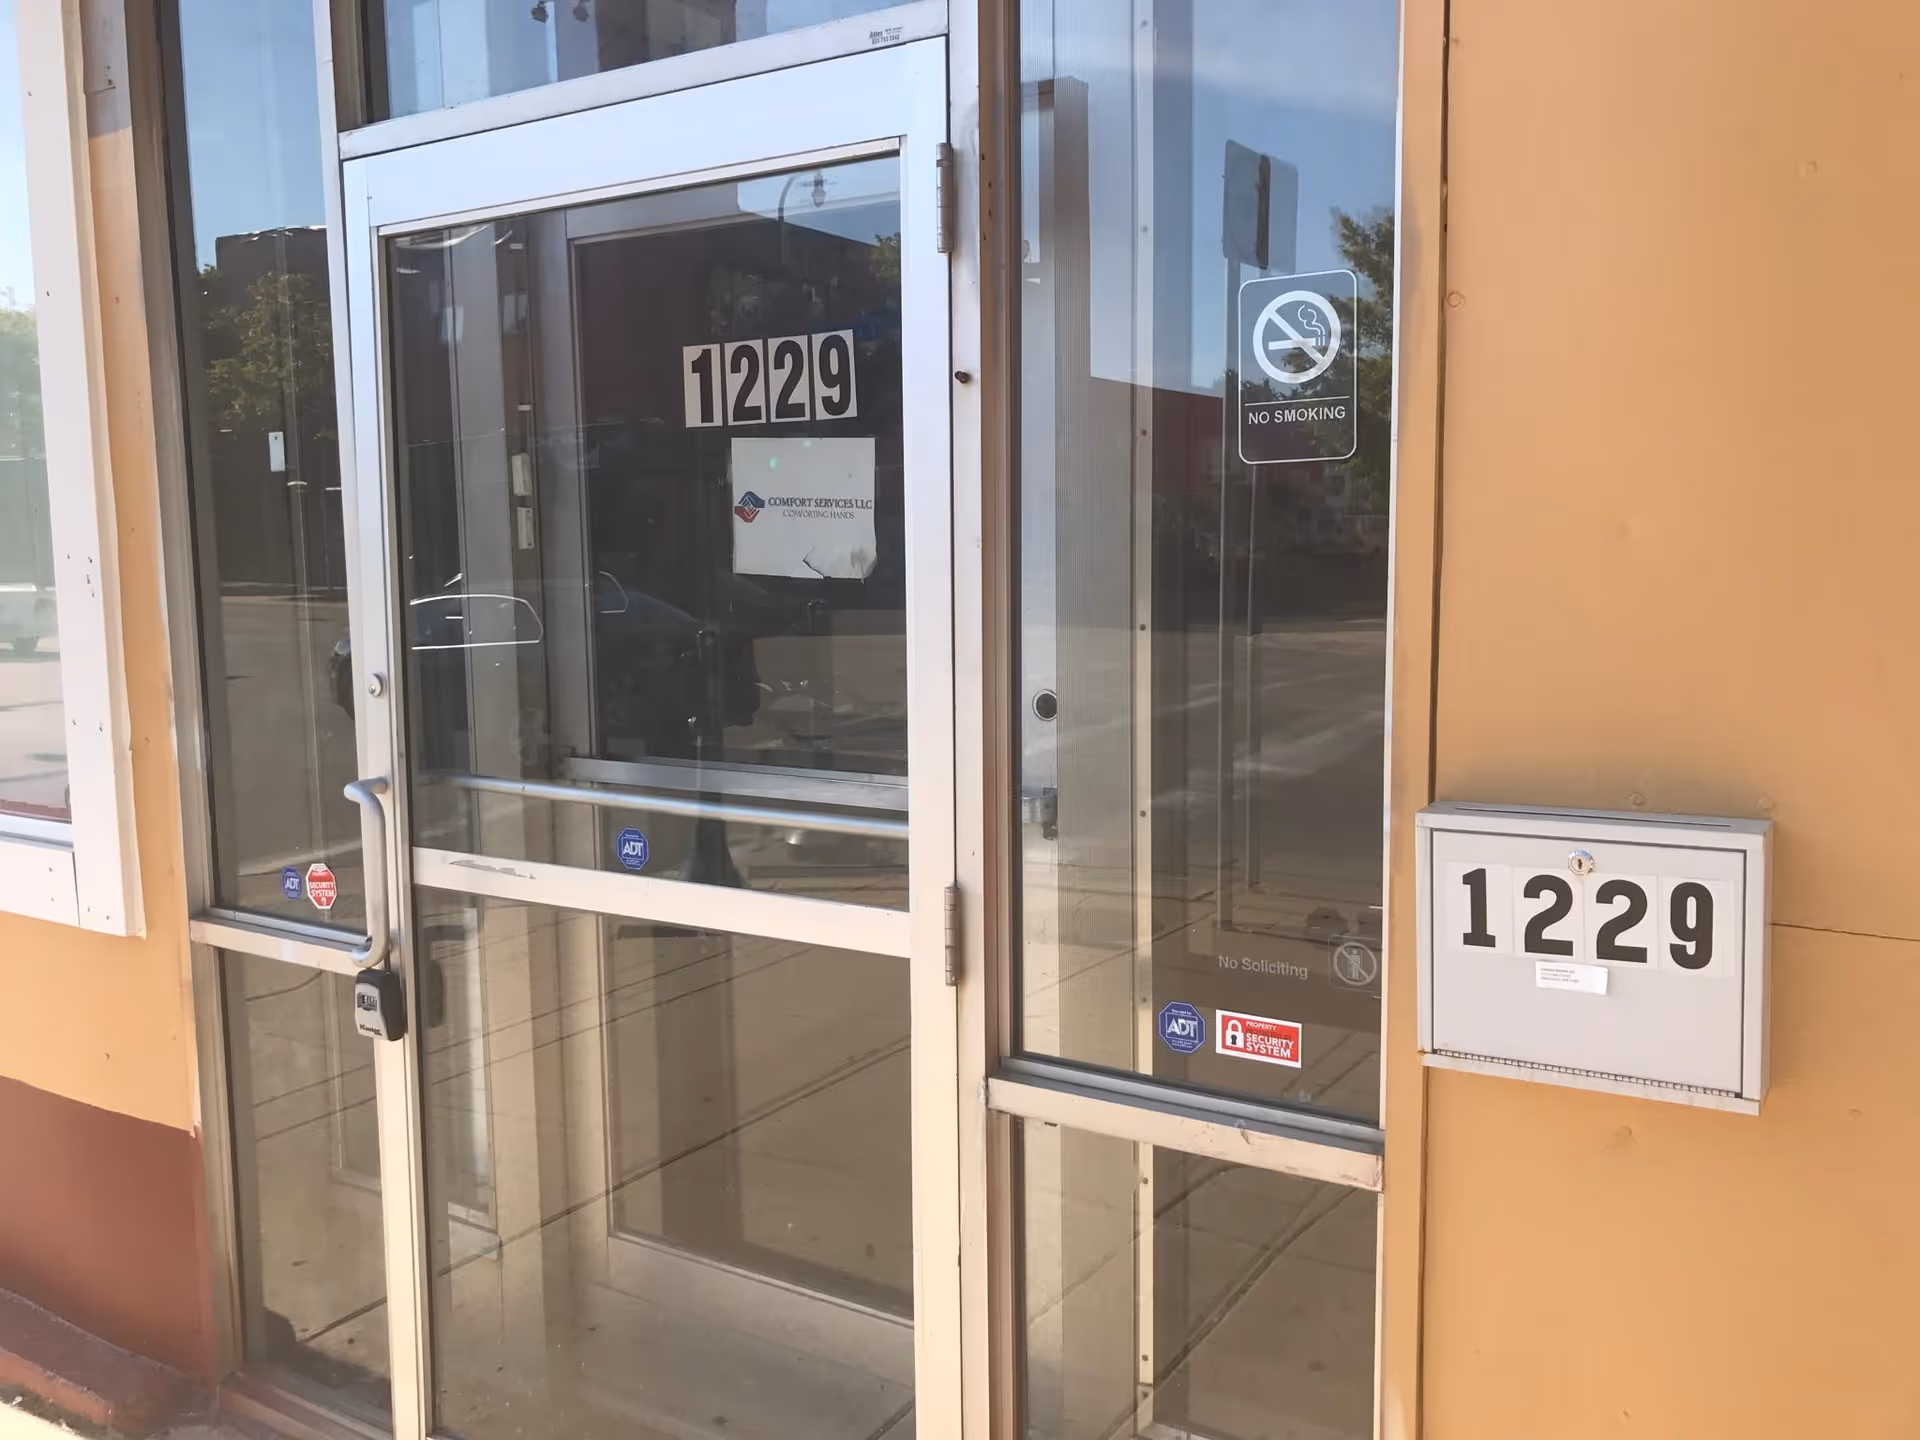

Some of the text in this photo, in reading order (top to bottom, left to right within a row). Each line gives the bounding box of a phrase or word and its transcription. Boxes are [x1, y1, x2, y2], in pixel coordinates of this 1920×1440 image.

[691, 334, 851, 424] 1229
[1248, 406, 1346, 425] NO SMOKING
[768, 497, 873, 510] COMFORT SERVICES LLC
[782, 509, 855, 519] COMFORTING HANDS
[623, 841, 643, 856] ADT
[285, 877, 299, 890] ADT
[309, 881, 334, 889] SECURITY
[310, 889, 335, 897] SYSTEM
[1462, 868, 1713, 970] 1229
[1218, 955, 1309, 980] No Soliciting
[1167, 1018, 1197, 1037] ADT
[1245, 1020, 1277, 1031] PROPERTY
[1246, 1032, 1295, 1049] SECURITY
[1246, 1041, 1291, 1059] SYSTEM
